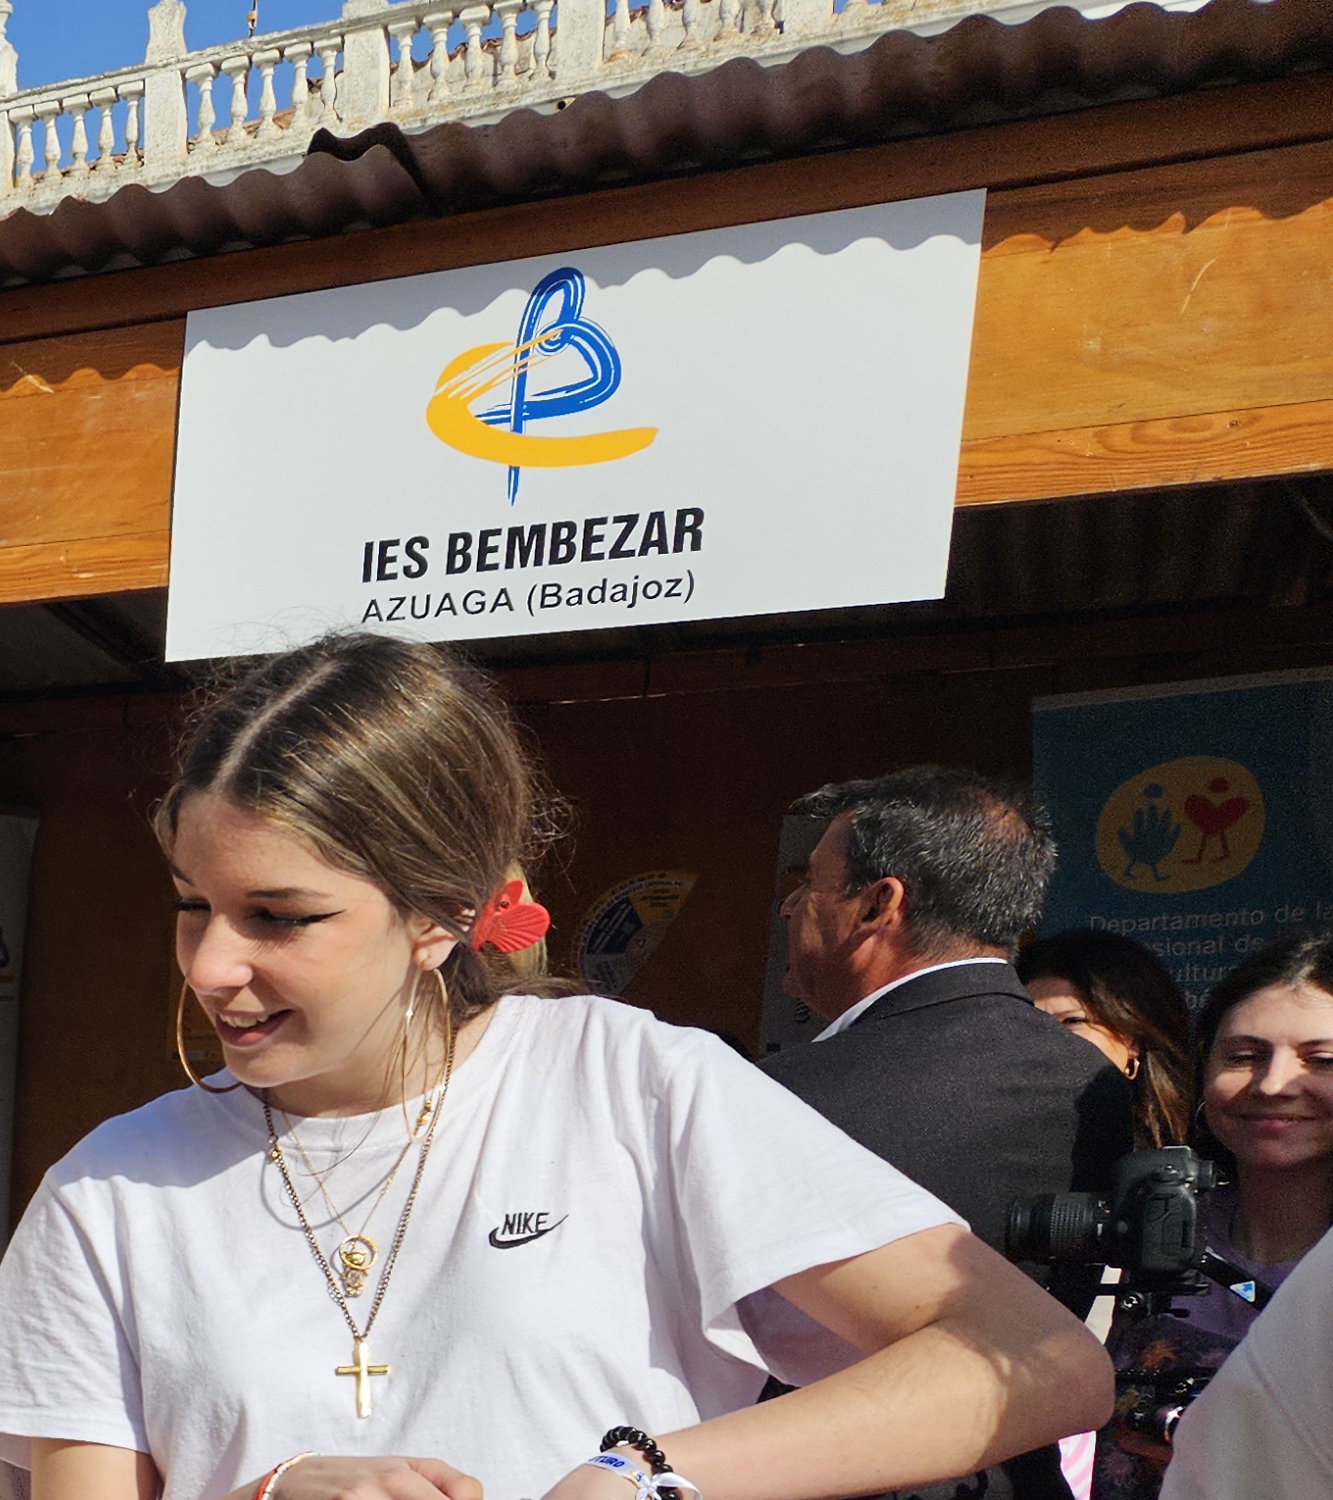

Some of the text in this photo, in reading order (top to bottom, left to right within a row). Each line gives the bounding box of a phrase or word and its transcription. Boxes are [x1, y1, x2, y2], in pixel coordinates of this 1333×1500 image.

[361, 506, 705, 583] IES BEMBEZAR
[361, 569, 696, 624] AZUAGA (Badajoz)
[1090, 906, 1265, 938] Departamento
[1274, 903, 1305, 923] de
[1146, 935, 1225, 959] sional
[501, 1211, 550, 1236] NIKE
